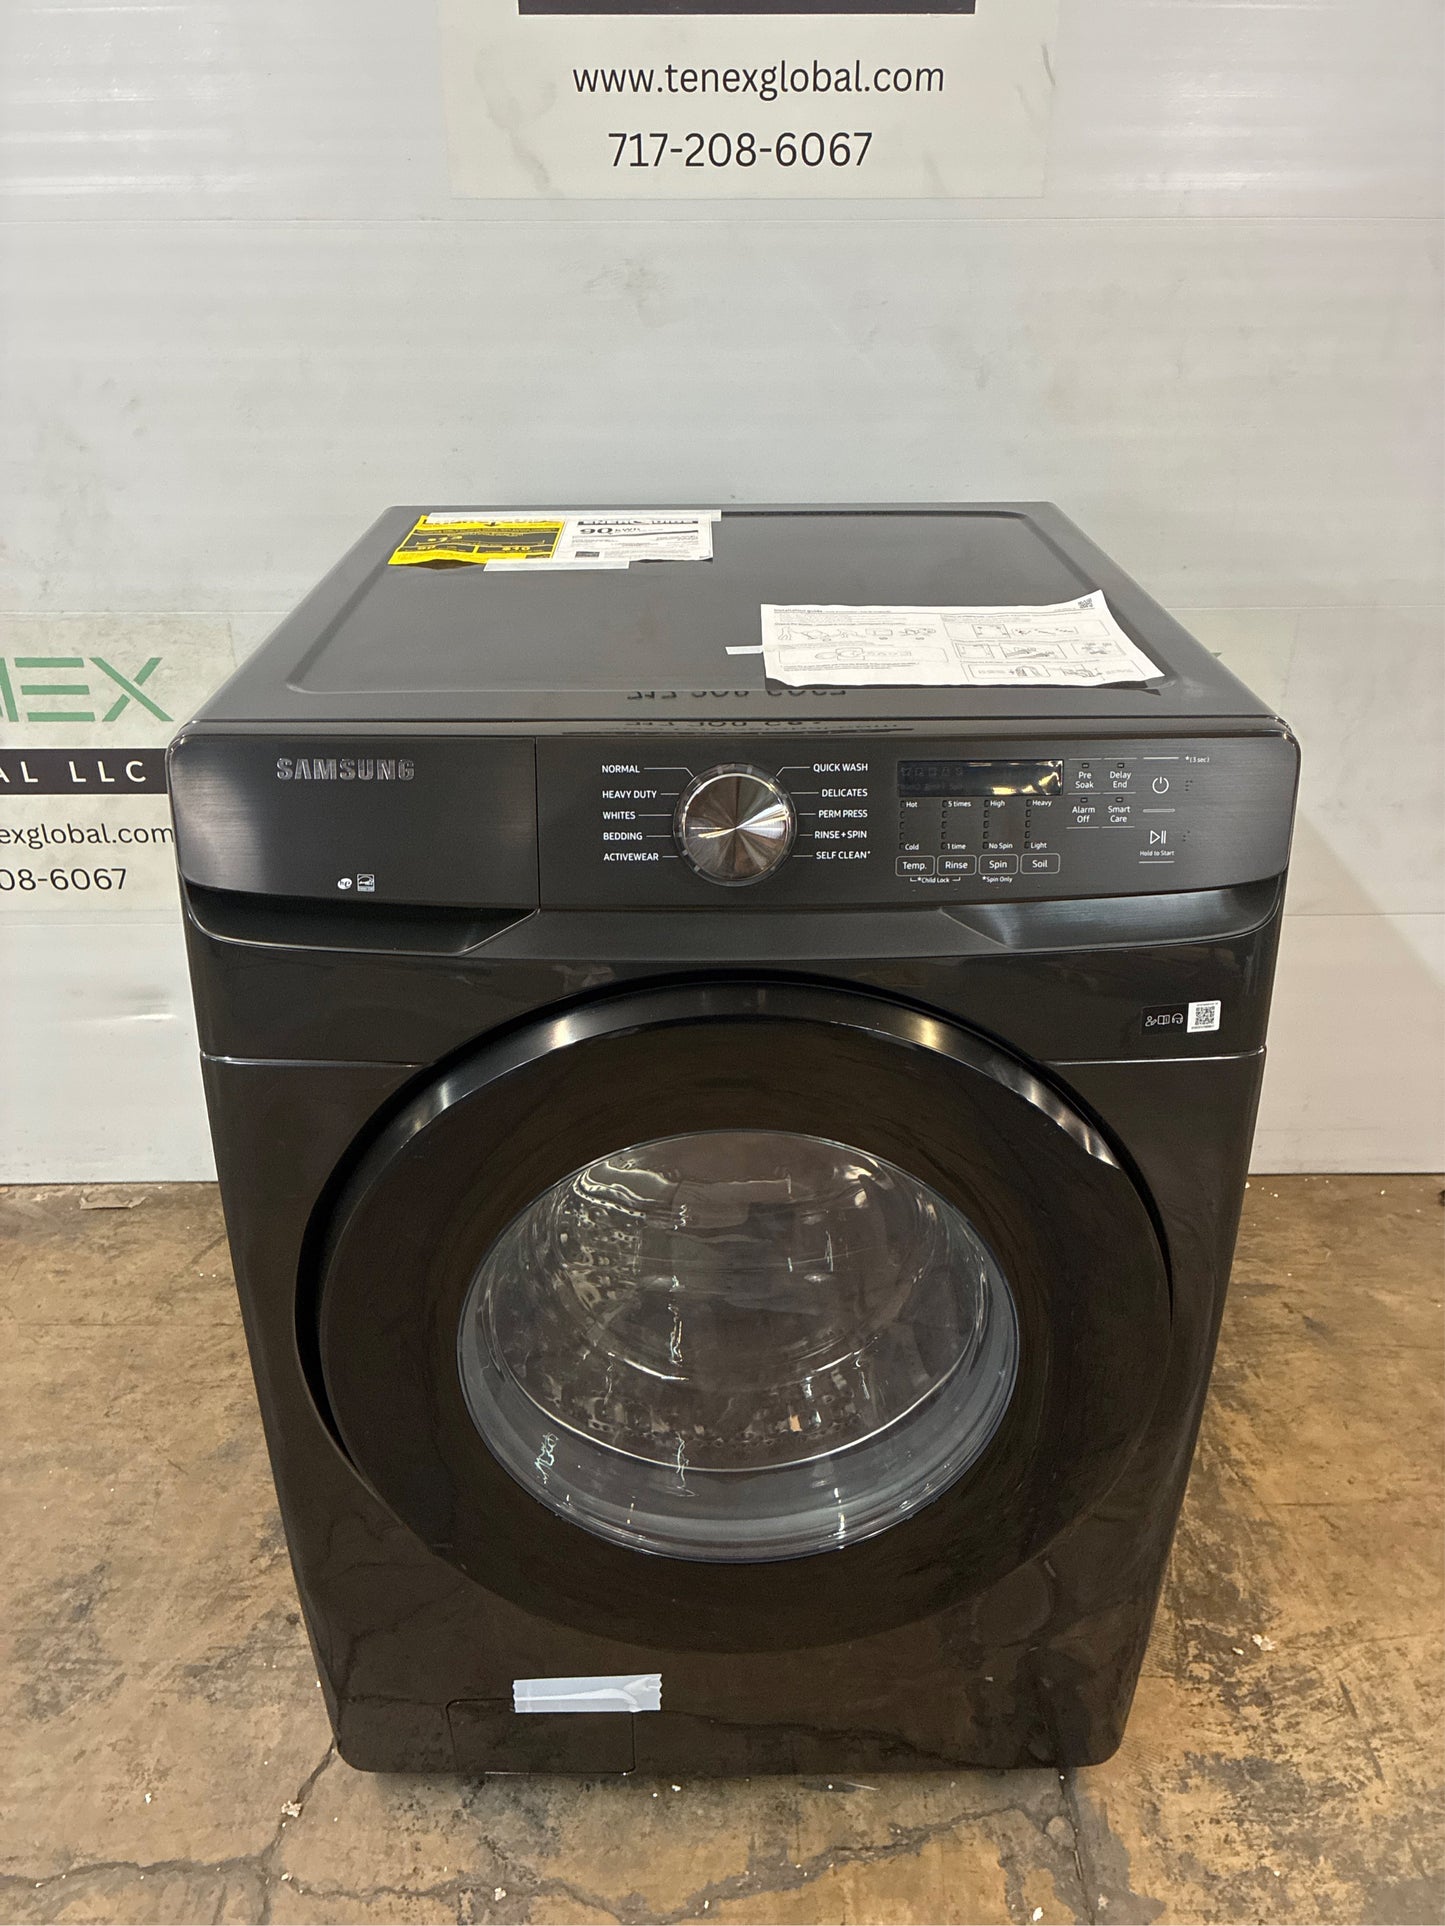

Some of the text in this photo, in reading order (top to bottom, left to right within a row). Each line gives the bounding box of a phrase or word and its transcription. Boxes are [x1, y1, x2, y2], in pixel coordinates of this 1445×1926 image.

[573, 61, 944, 100] www.tenexglobal.com
[608, 132, 872, 167] 717-208-6067
[0, 657, 174, 722] EX
[69, 761, 147, 783] LLC
[276, 758, 415, 781] SAMSUNG
[601, 765, 640, 773] NORMAL
[813, 763, 868, 772] QUICK WASH
[1078, 771, 1092, 779] Pre
[1109, 771, 1132, 780] Delay
[1075, 781, 1094, 789] Soak
[602, 790, 657, 799] HEAVY DUTY
[822, 788, 868, 797] DELICATES
[990, 800, 1005, 808] High
[1032, 799, 1052, 807] Heavy
[818, 809, 868, 818] PERM PRESS
[1072, 806, 1096, 814] Alarm
[602, 811, 636, 820] WHITES
[1077, 815, 1090, 823] Off
[1110, 815, 1128, 823] Care
[603, 832, 643, 841] BEDDING
[814, 831, 840, 839] RINSE
[847, 830, 867, 839] SPIN
[999, 842, 1013, 850] Spin
[603, 853, 659, 861] ACTIVEWEAR
[816, 851, 836, 860] SELF
[902, 861, 927, 871] Temp.
[945, 860, 968, 869] Rinse
[989, 859, 1008, 870] Spin
[1032, 859, 1048, 868] Soil
